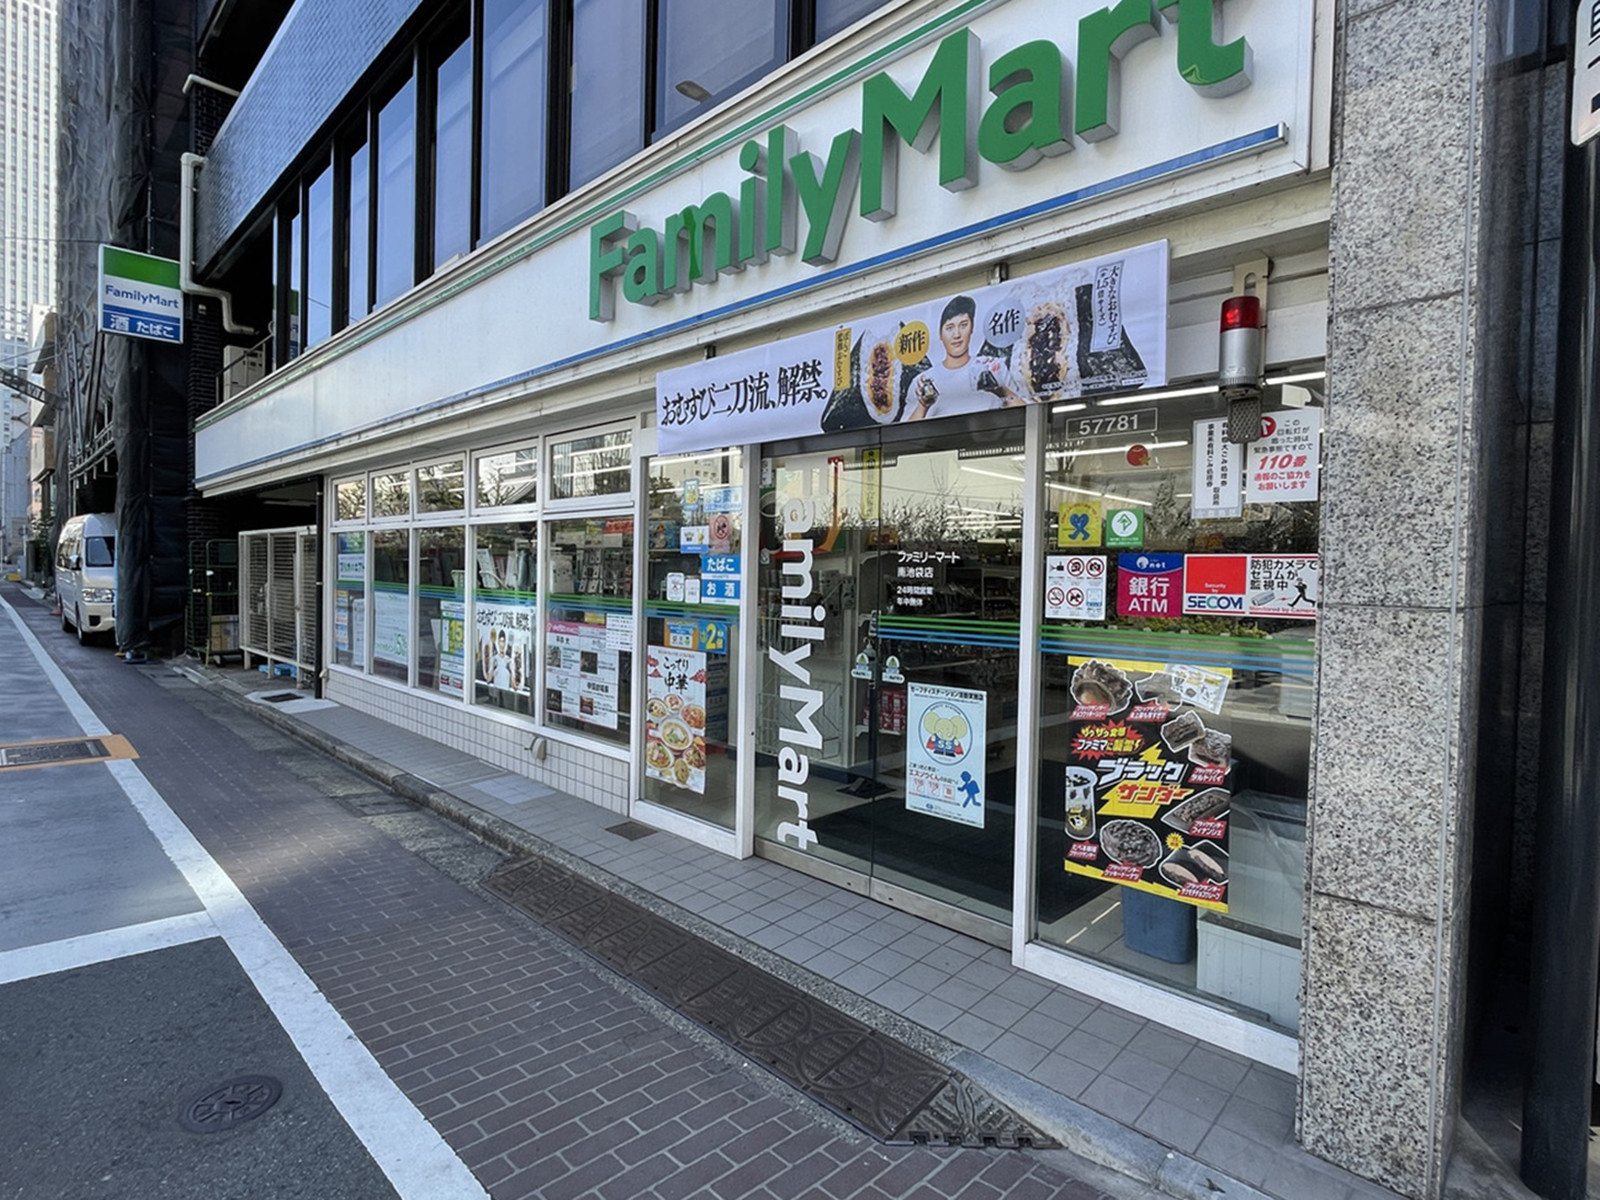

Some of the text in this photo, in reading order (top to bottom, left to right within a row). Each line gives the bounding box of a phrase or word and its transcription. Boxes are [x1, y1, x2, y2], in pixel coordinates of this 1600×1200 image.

[590, 0, 1252, 323] FamilyMart
[105, 285, 179, 308] FamilyMart
[1107, 266, 1120, 345] 大きなおむすび
[110, 314, 174, 338] 酒 たばこ
[988, 308, 1021, 336] 名作
[899, 330, 926, 355] 新作
[661, 359, 828, 426] おむすび二刀流、解禁。
[1079, 414, 1139, 436] 57781
[1284, 419, 1300, 427] この
[1259, 454, 1308, 470] 110番
[1254, 470, 1311, 481] 通報のご協力を
[1258, 481, 1307, 491] お願いします
[707, 557, 735, 572] たばこ
[897, 551, 960, 564] ファミリーマート
[1250, 560, 1317, 570] 防犯カメラで
[1250, 570, 1298, 580] セコムが
[1129, 577, 1170, 597] 銀行
[1250, 580, 1288, 591] 監視中
[1128, 598, 1168, 613] ATM
[1188, 596, 1242, 609] SECOM
[769, 456, 830, 850] FamilyMart
[663, 656, 689, 672] こってり
[664, 671, 688, 694] 中華
[937, 740, 953, 750] SS
[1097, 758, 1186, 787] ブラック
[1117, 784, 1195, 805] サンダー
